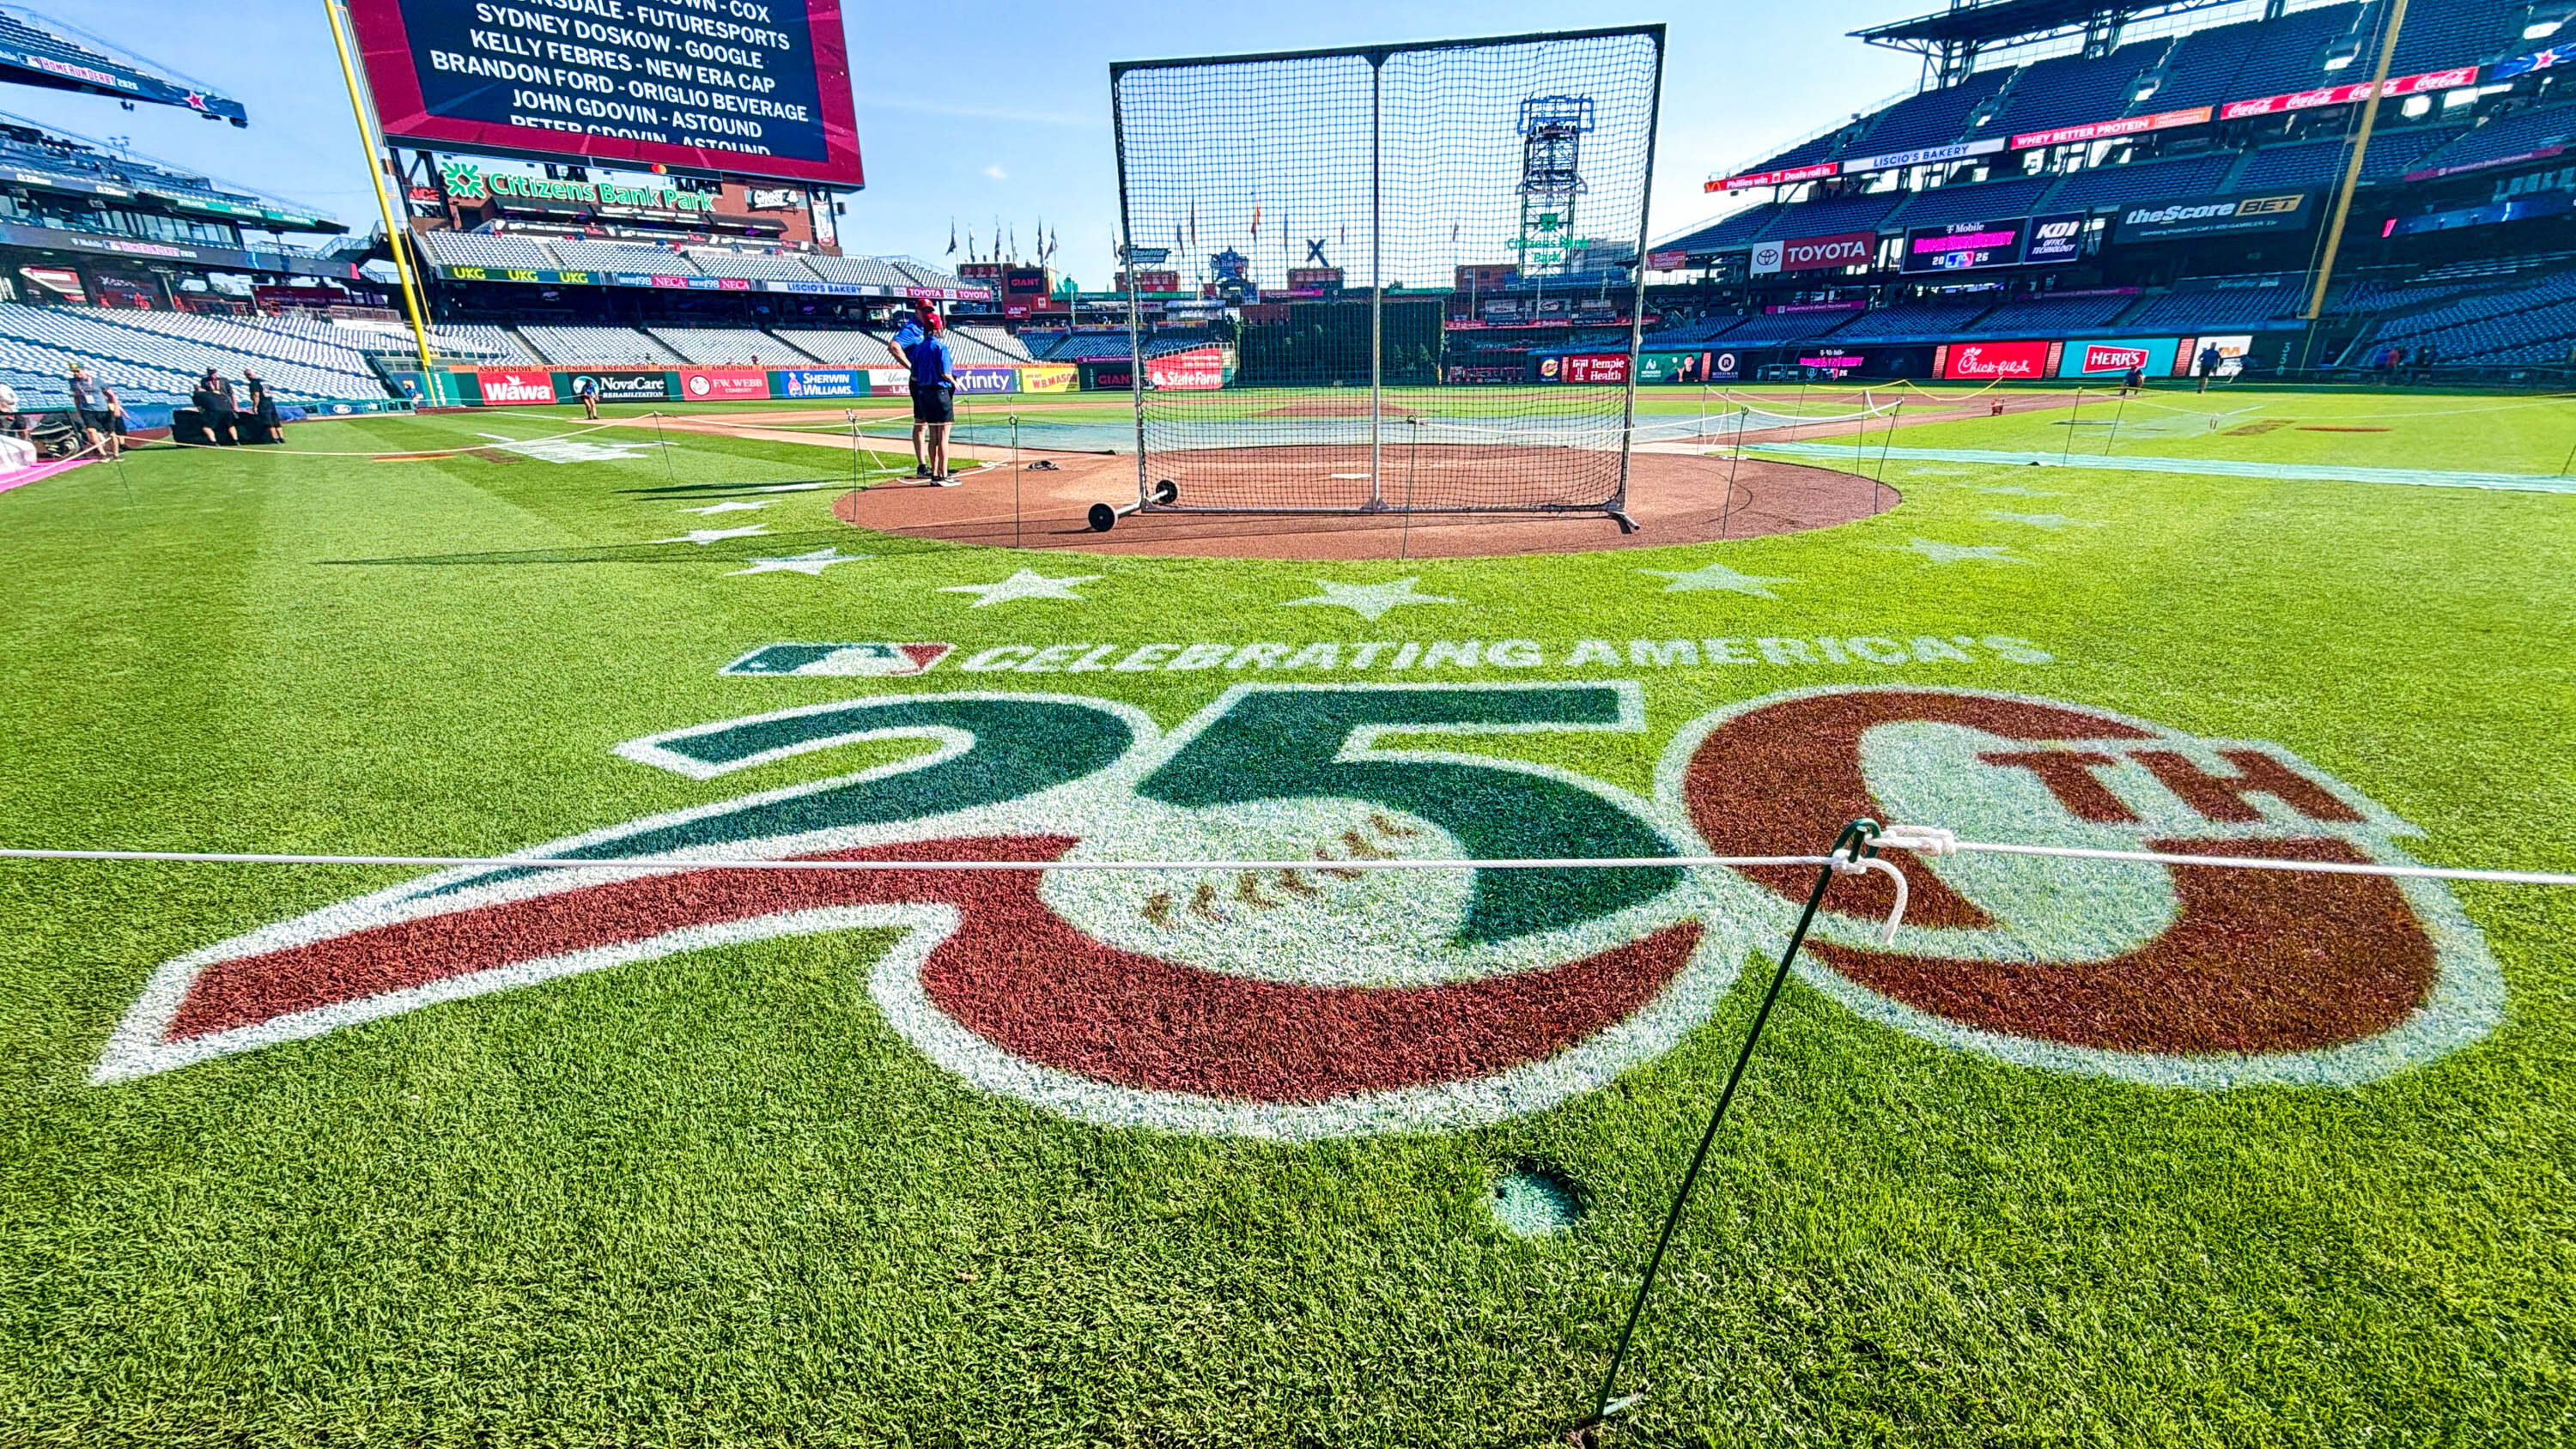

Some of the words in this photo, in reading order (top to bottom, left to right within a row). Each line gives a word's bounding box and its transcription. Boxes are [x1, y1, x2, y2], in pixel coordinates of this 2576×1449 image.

[730, 1, 771, 24] COX
[476, 3, 570, 36] SYDNEY
[574, 20, 671, 53] DOSKOW
[685, 39, 764, 70] GOOGLE
[637, 6, 790, 50] FUTURESPORTS
[470, 28, 542, 58] KELLY
[546, 40, 633, 72] FEBRES
[646, 58, 693, 82] NEW
[696, 66, 737, 88] ERA
[738, 74, 775, 94] CAP
[430, 50, 551, 86] BRANDON
[554, 68, 614, 94] FORD
[629, 81, 709, 107] ORIGLIO
[712, 92, 809, 122] BEVERAGE
[2415, 69, 2469, 90] Coca-Cola
[2287, 90, 2334, 109] Coca-Cola
[513, 88, 573, 114] JOHN
[575, 97, 659, 125] GDOVIN
[672, 111, 762, 138] ASTOUND
[2228, 100, 2274, 118] Coca-Cola
[2017, 134, 2053, 146] WHEY
[2053, 128, 2094, 142] BETTER
[2096, 121, 2149, 136] PROTEIN
[1874, 153, 1919, 167] LISCIO'S
[1923, 145, 1970, 160] BAKERY
[489, 172, 595, 203] Citizens
[598, 182, 661, 208] Bank
[661, 189, 716, 213] Park
[2125, 203, 2236, 224] theScore
[2241, 197, 2302, 214] BET
[1956, 222, 1985, 233] Mobile
[2032, 244, 2075, 255] TECHNOLOGY
[2043, 238, 2067, 247] OFFICE
[1788, 240, 1866, 264] TOYOTA
[1932, 256, 1945, 266] 20
[1975, 252, 1990, 263] 26
[453, 267, 486, 280] UKG
[507, 270, 539, 282] UKG
[559, 272, 589, 284] UKG
[653, 277, 687, 288] NECA
[721, 279, 750, 290] NECA
[1011, 277, 1040, 288] GIANT
[787, 282, 826, 293] LISCIO'S
[828, 284, 862, 294] BAKERY
[910, 288, 942, 298] TOYOTA
[959, 290, 990, 300] TOYOTA
[1591, 357, 1625, 373] Temple
[1958, 347, 2031, 376] Chick-fil-A
[2090, 351, 2142, 367] HERR'S
[600, 378, 665, 391] NovaCare
[733, 379, 762, 387] WEBB
[803, 372, 850, 385] SHERWIN
[1590, 370, 1622, 381] Health
[484, 383, 551, 401] Wawa
[961, 639, 1543, 673] CELEBRATING
[1564, 634, 2056, 668] AMERICA'S
[94, 682, 2503, 1133] 250
